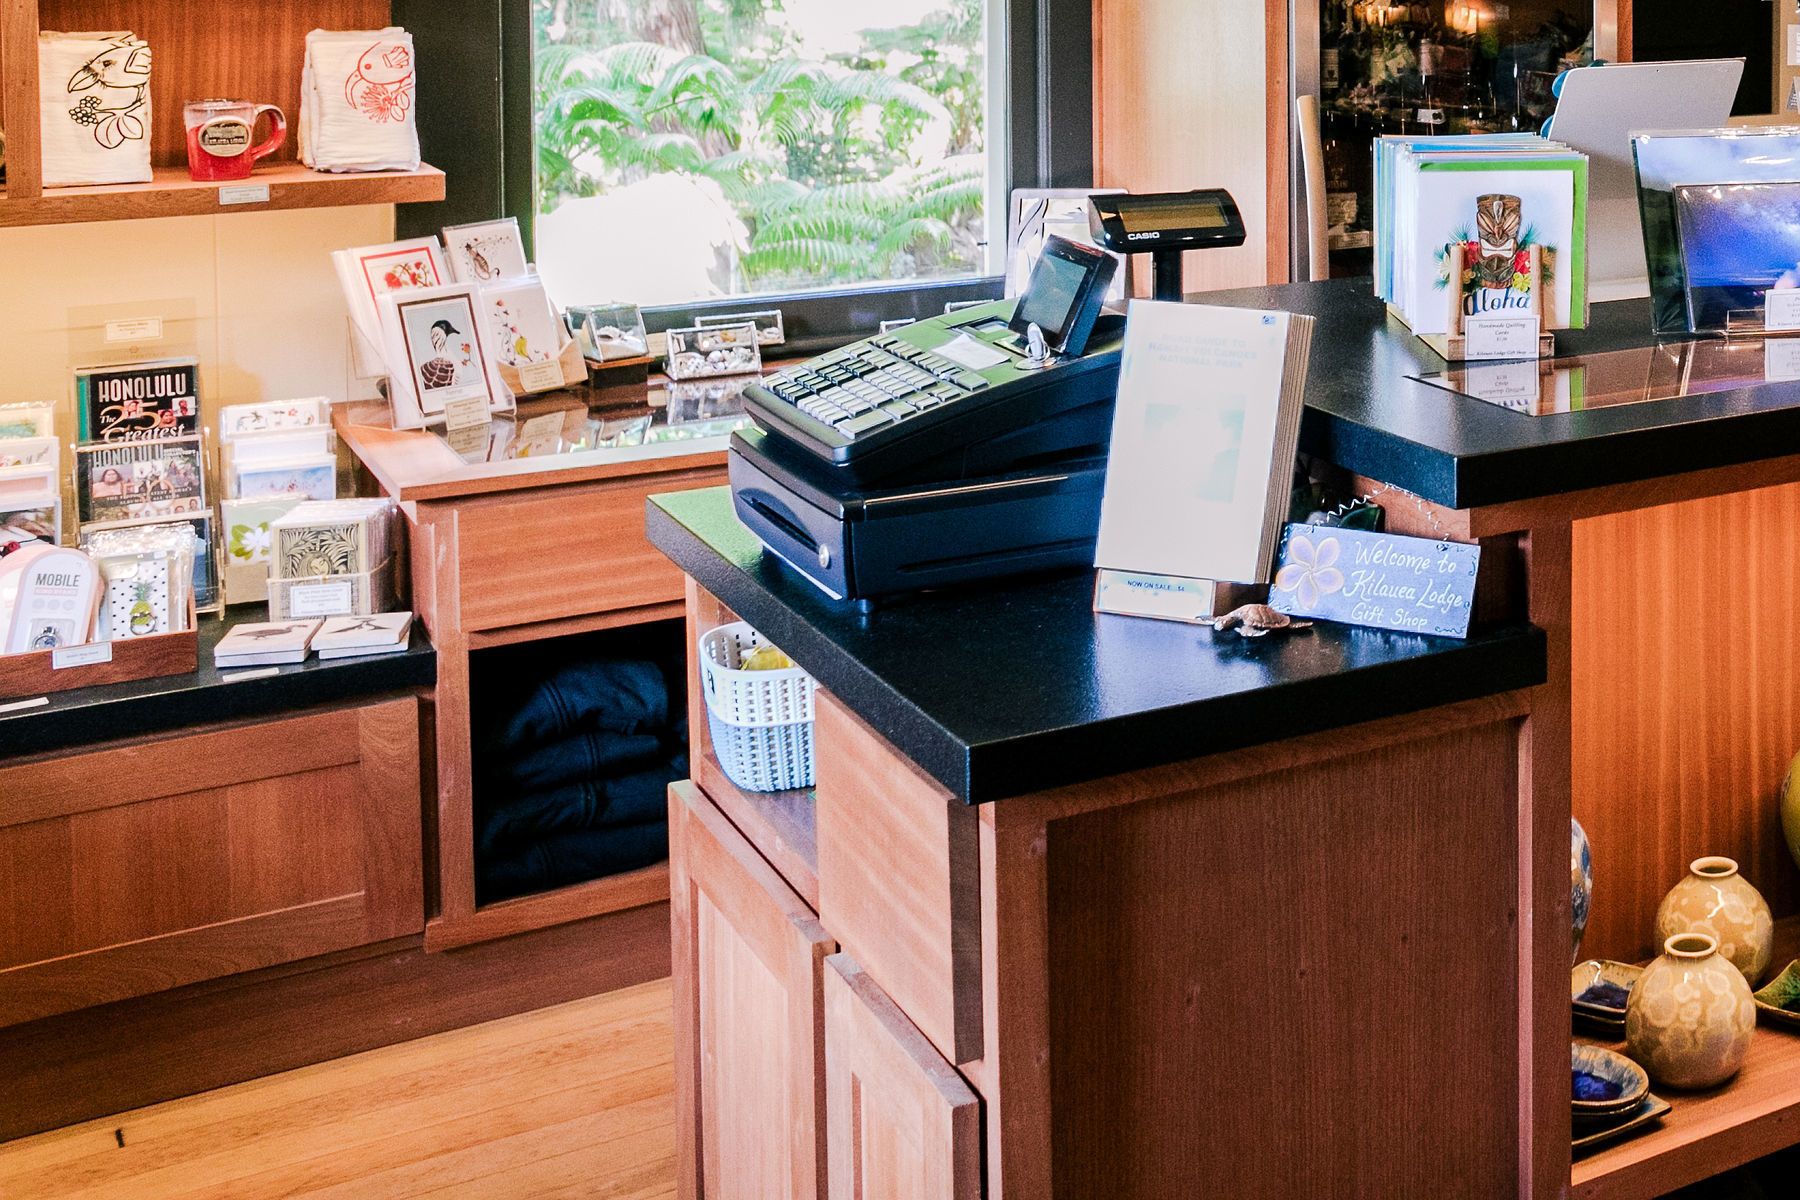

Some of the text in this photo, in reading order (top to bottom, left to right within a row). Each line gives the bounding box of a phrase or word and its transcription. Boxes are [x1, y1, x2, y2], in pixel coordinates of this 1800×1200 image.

[1128, 231, 1160, 241] CASIO
[98, 373, 187, 403] HONOLULU
[100, 415, 116, 424] The
[105, 424, 185, 443] Greatest
[1354, 540, 1457, 575] Welcome to
[35, 573, 81, 587] MOBILE
[1127, 580, 1142, 588] NOW
[1154, 583, 1171, 591] SALE
[1342, 571, 1463, 614] Kilauea Lodge
[1351, 602, 1428, 631] Gift Shop
